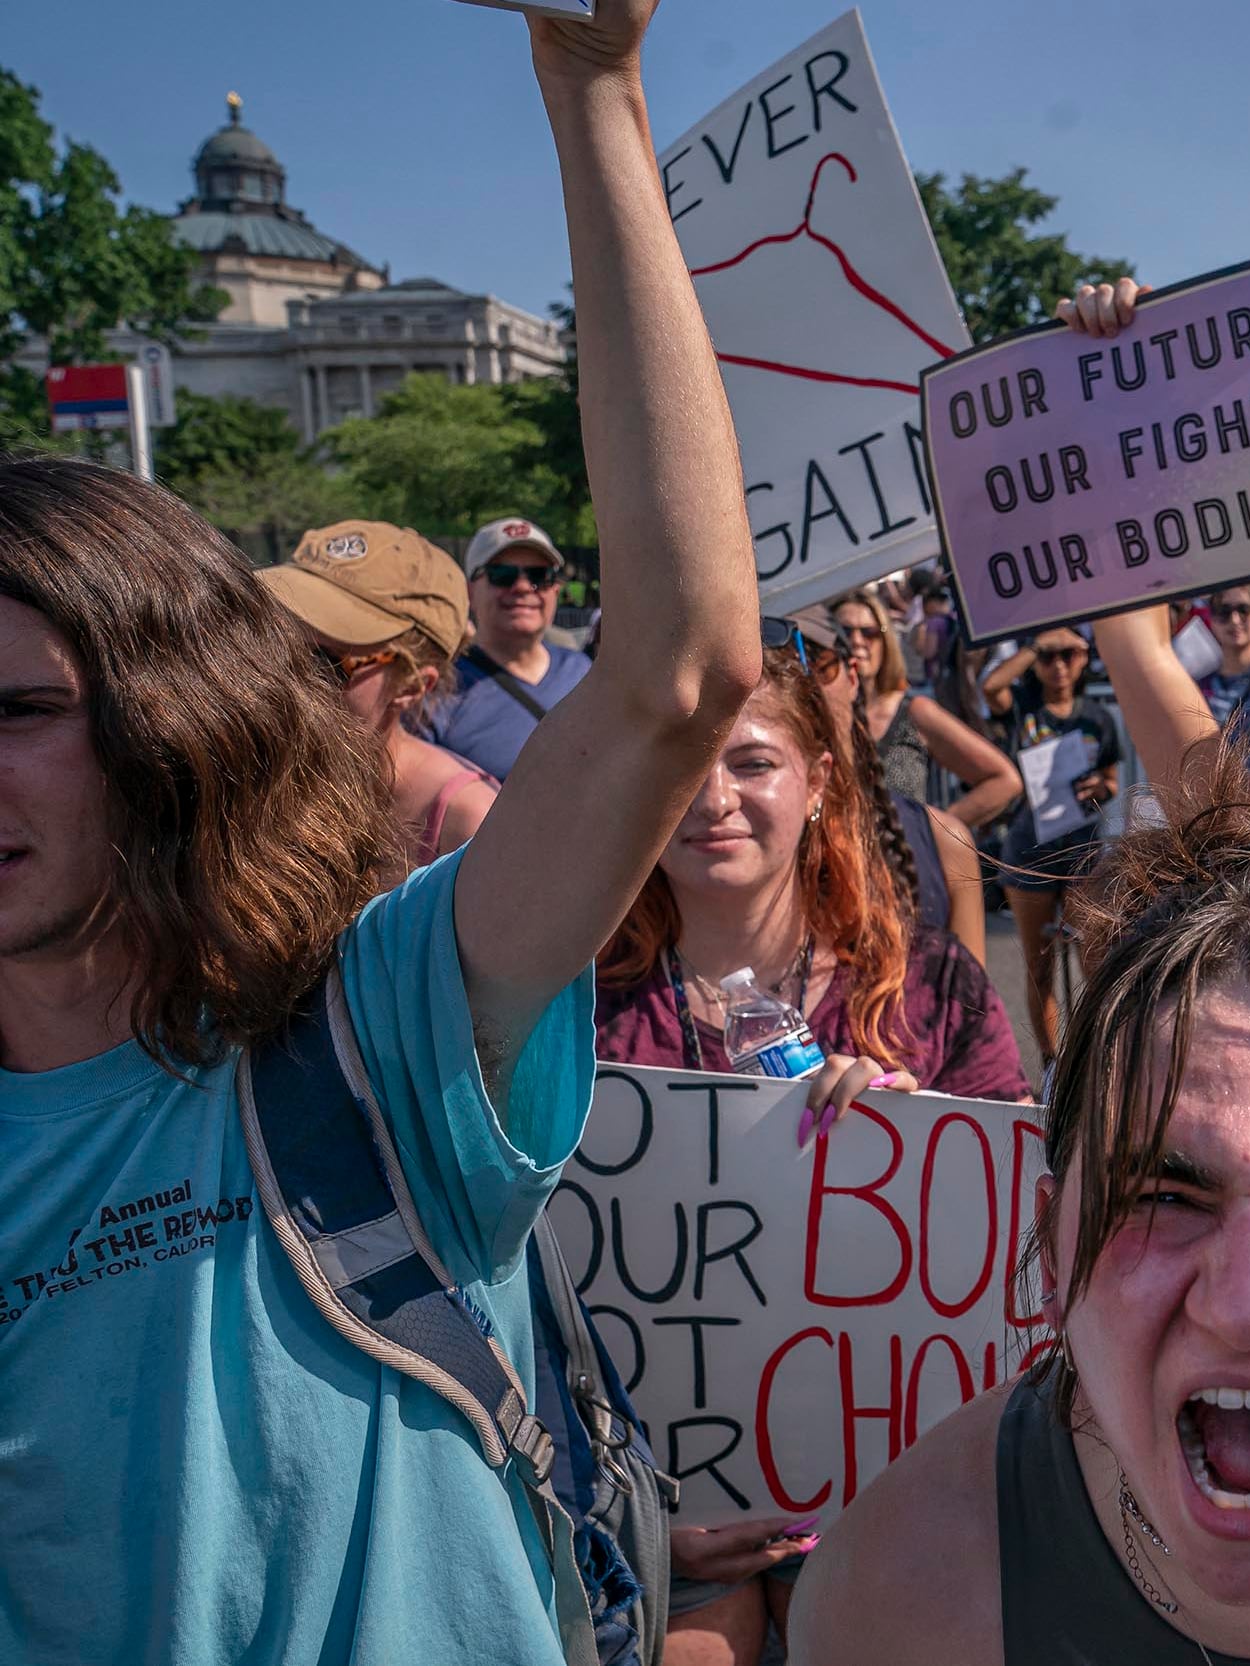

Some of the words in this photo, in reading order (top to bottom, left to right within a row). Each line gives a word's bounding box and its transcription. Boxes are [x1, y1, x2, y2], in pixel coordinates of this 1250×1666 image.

[662, 49, 859, 223] EVER
[948, 367, 1050, 439] OUR
[984, 443, 1093, 514] OUR
[987, 532, 1096, 599] OUR
[572, 1068, 760, 1186] OT
[99, 1178, 193, 1229] Annual
[84, 1221, 158, 1263] THE
[46, 1257, 148, 1299] FELTON,
